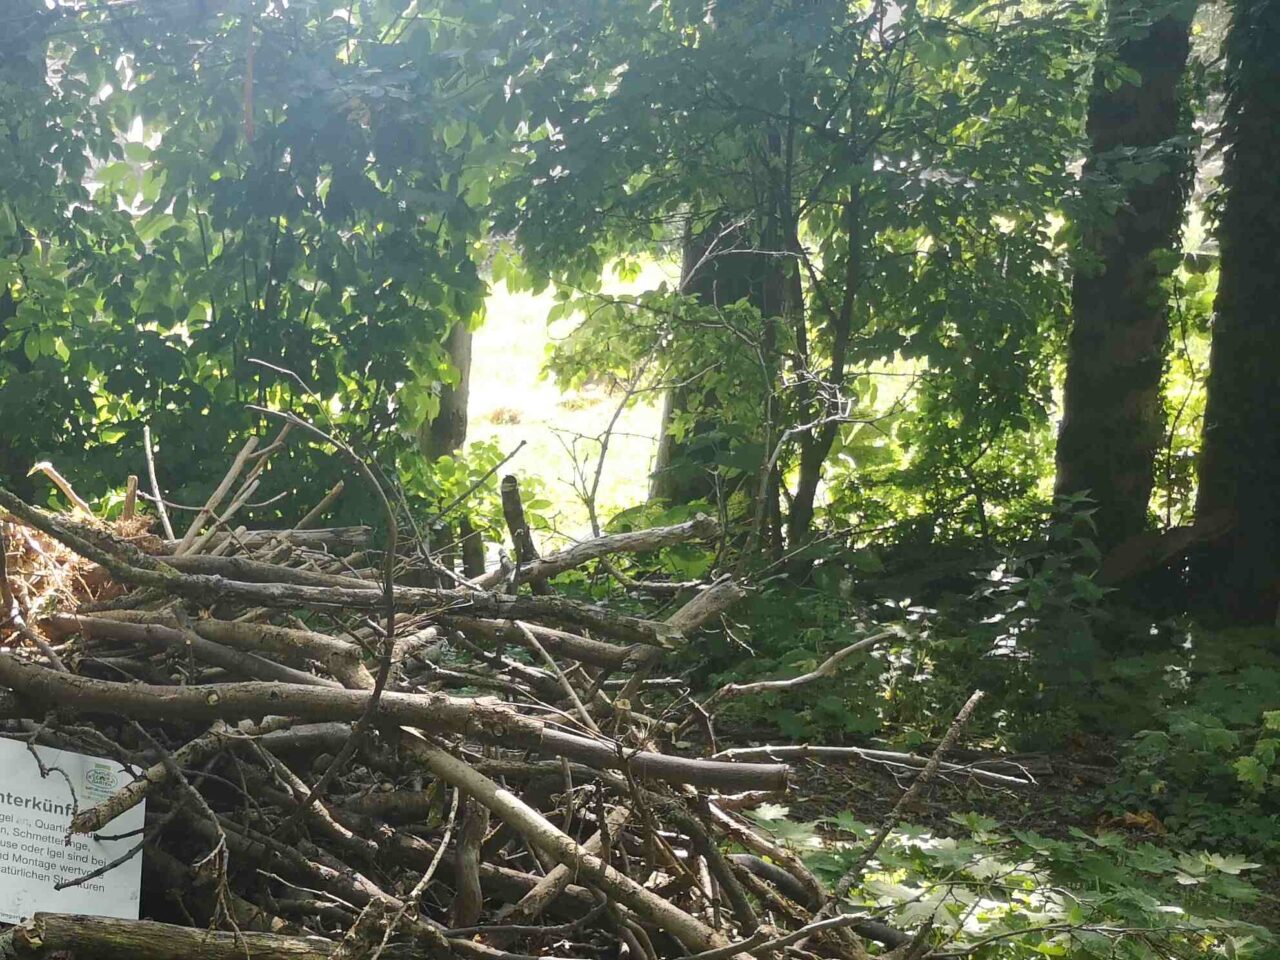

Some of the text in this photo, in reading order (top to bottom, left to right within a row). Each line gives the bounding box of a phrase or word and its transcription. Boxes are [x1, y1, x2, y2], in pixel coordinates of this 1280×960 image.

[12, 853, 57, 870] Montage
[20, 841, 45, 854] oder
[47, 847, 65, 859] Igel
[67, 851, 88, 863] sind
[91, 855, 107, 867] bei
